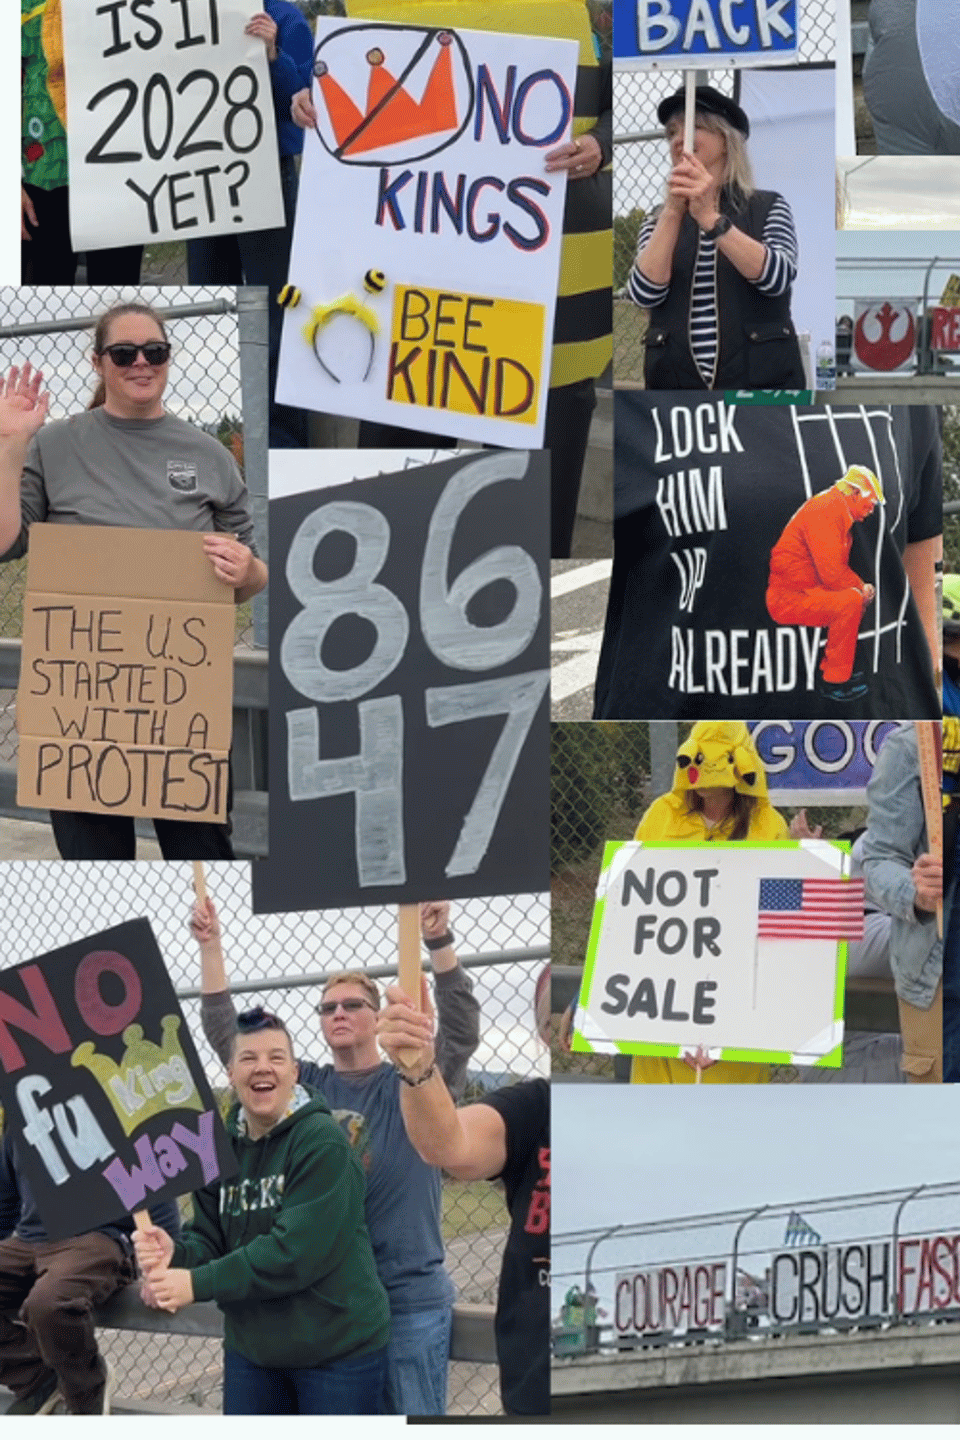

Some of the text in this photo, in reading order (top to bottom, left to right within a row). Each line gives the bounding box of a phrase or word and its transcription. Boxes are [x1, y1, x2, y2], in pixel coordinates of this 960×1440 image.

[85, 65, 264, 165] 2028
[474, 63, 572, 148] NO
[125, 161, 250, 235] YET?
[374, 167, 552, 253] KINGS
[399, 287, 495, 355] BEE
[386, 341, 535, 418] KIND
[651, 400, 745, 464] LOCK
[656, 465, 729, 538] HIM
[671, 547, 708, 613] UP
[32, 605, 213, 669] THE U.S.
[668, 625, 822, 697] ALREADY
[30, 658, 188, 706] STARTED
[52, 705, 209, 748] WITH A
[36, 742, 230, 817] PROTEST
[284, 668, 552, 888] 47
[620, 867, 720, 908] NOT
[633, 914, 722, 959] FOR
[0, 949, 143, 1074] NO
[600, 973, 718, 1026] SALE
[614, 1263, 727, 1334] COURAGE
[771, 1243, 891, 1323] CRUSH
